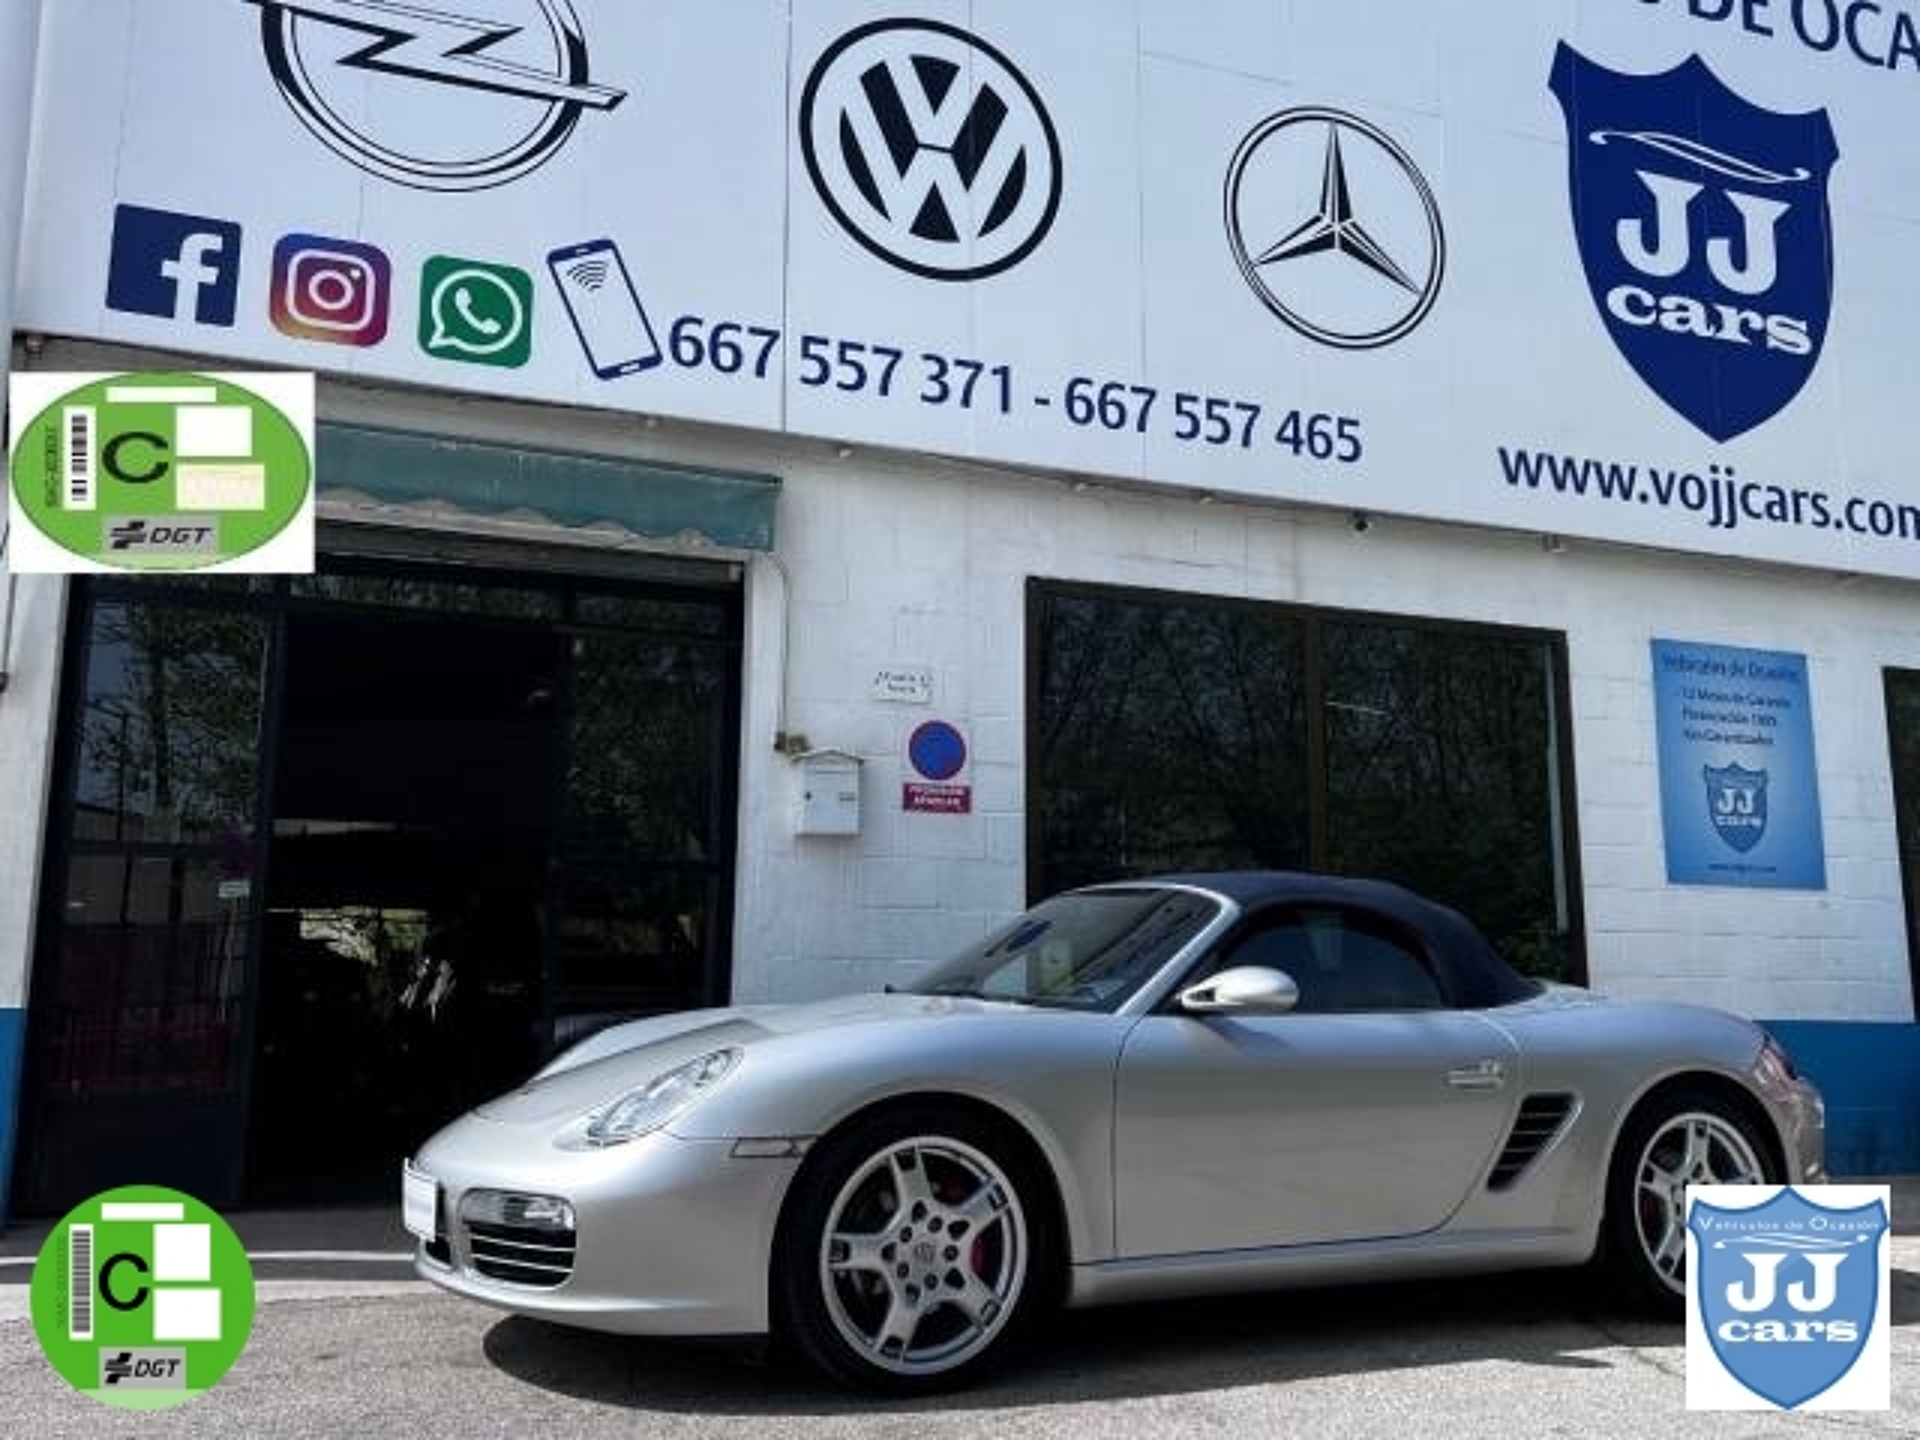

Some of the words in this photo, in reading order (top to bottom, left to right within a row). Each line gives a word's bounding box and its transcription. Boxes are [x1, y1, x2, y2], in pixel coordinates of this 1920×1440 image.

[1616, 168, 1792, 295] JJ
[1606, 285, 1812, 355] cars
[668, 316, 781, 380] 667
[800, 335, 903, 398] 557
[920, 353, 1013, 414] 371
[1064, 376, 1157, 434] 667
[1174, 391, 1262, 449] 557
[1275, 409, 1363, 464] 465
[1718, 788, 1755, 814] JJ
